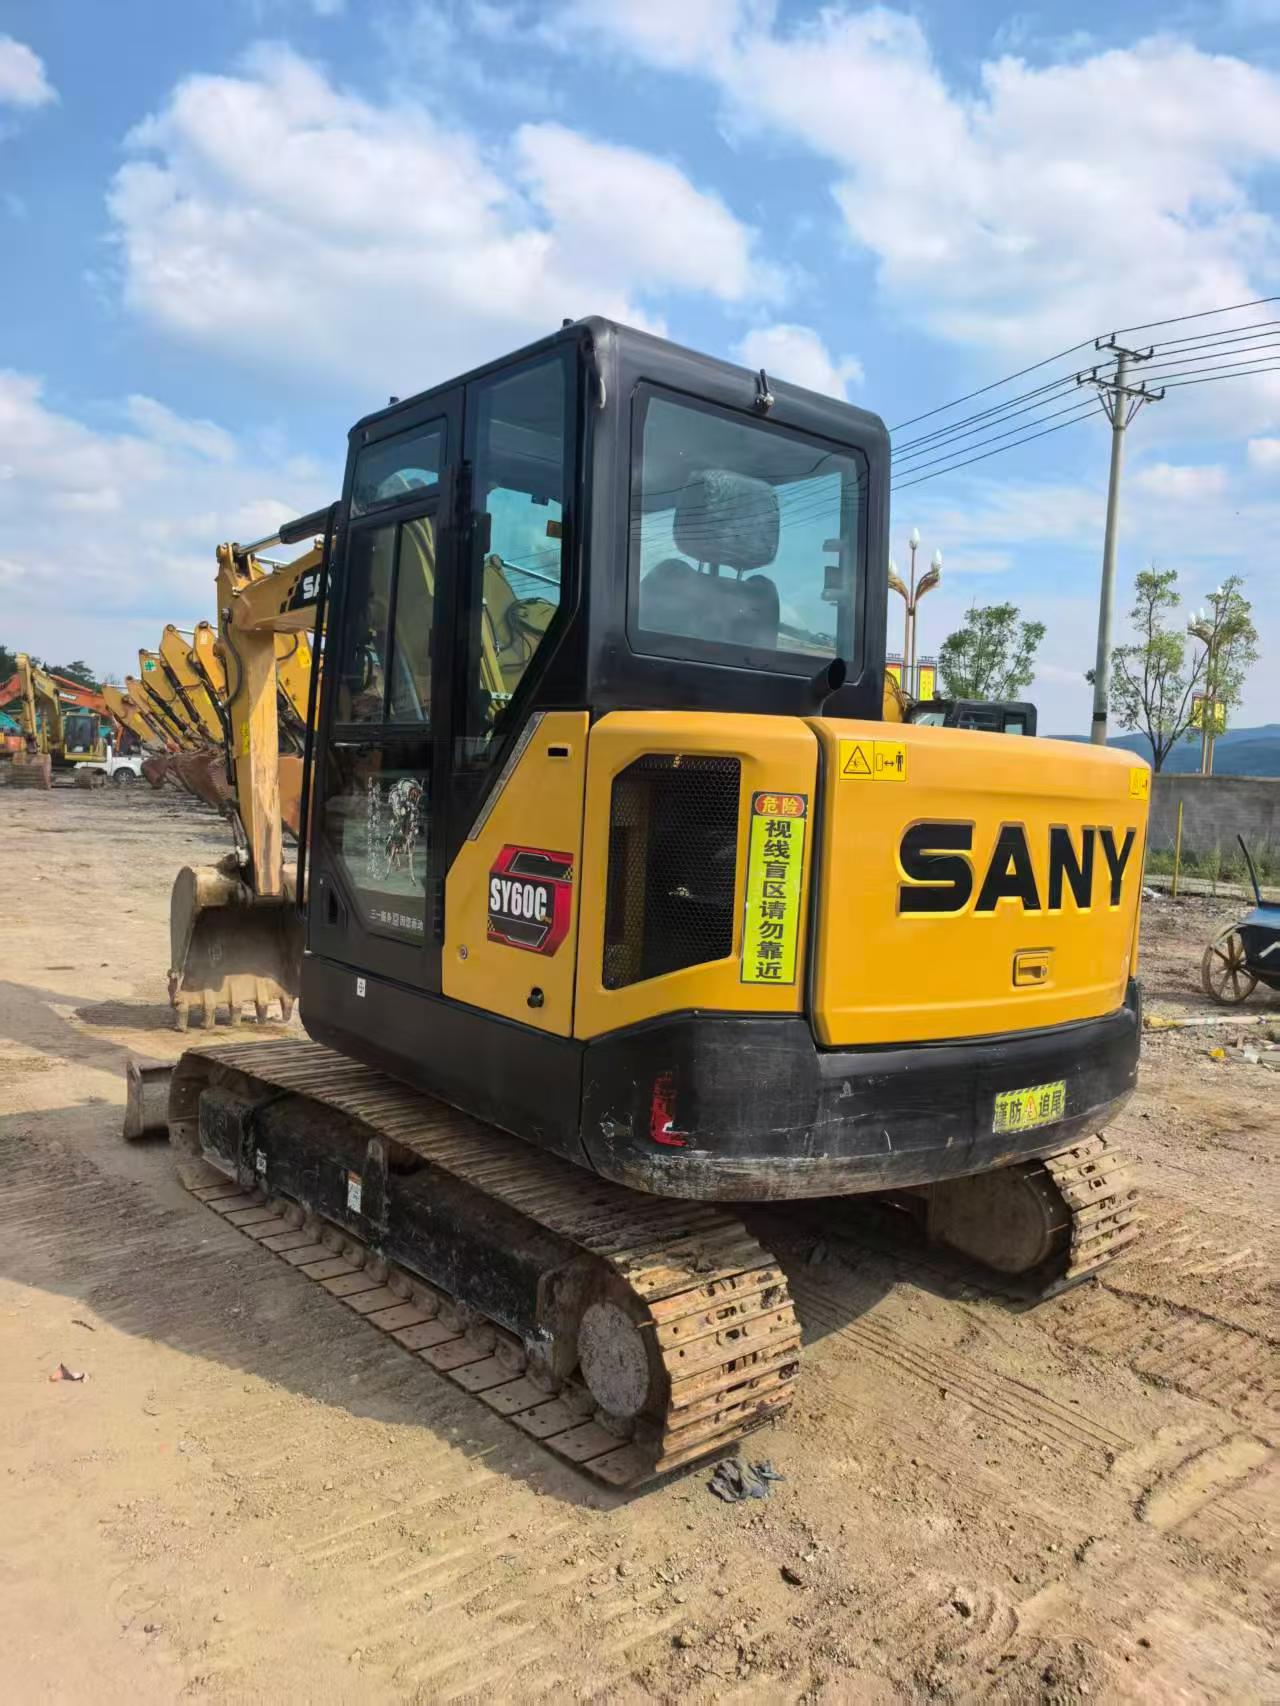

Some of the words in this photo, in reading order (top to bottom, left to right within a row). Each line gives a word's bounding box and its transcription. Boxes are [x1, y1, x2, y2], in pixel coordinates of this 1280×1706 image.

[303, 573, 332, 599] SA
[762, 796, 798, 815] 危险
[898, 820, 1137, 914] SANY
[490, 878, 547, 922] SY60C
[755, 819, 792, 979] 视线盲区请勿靠近
